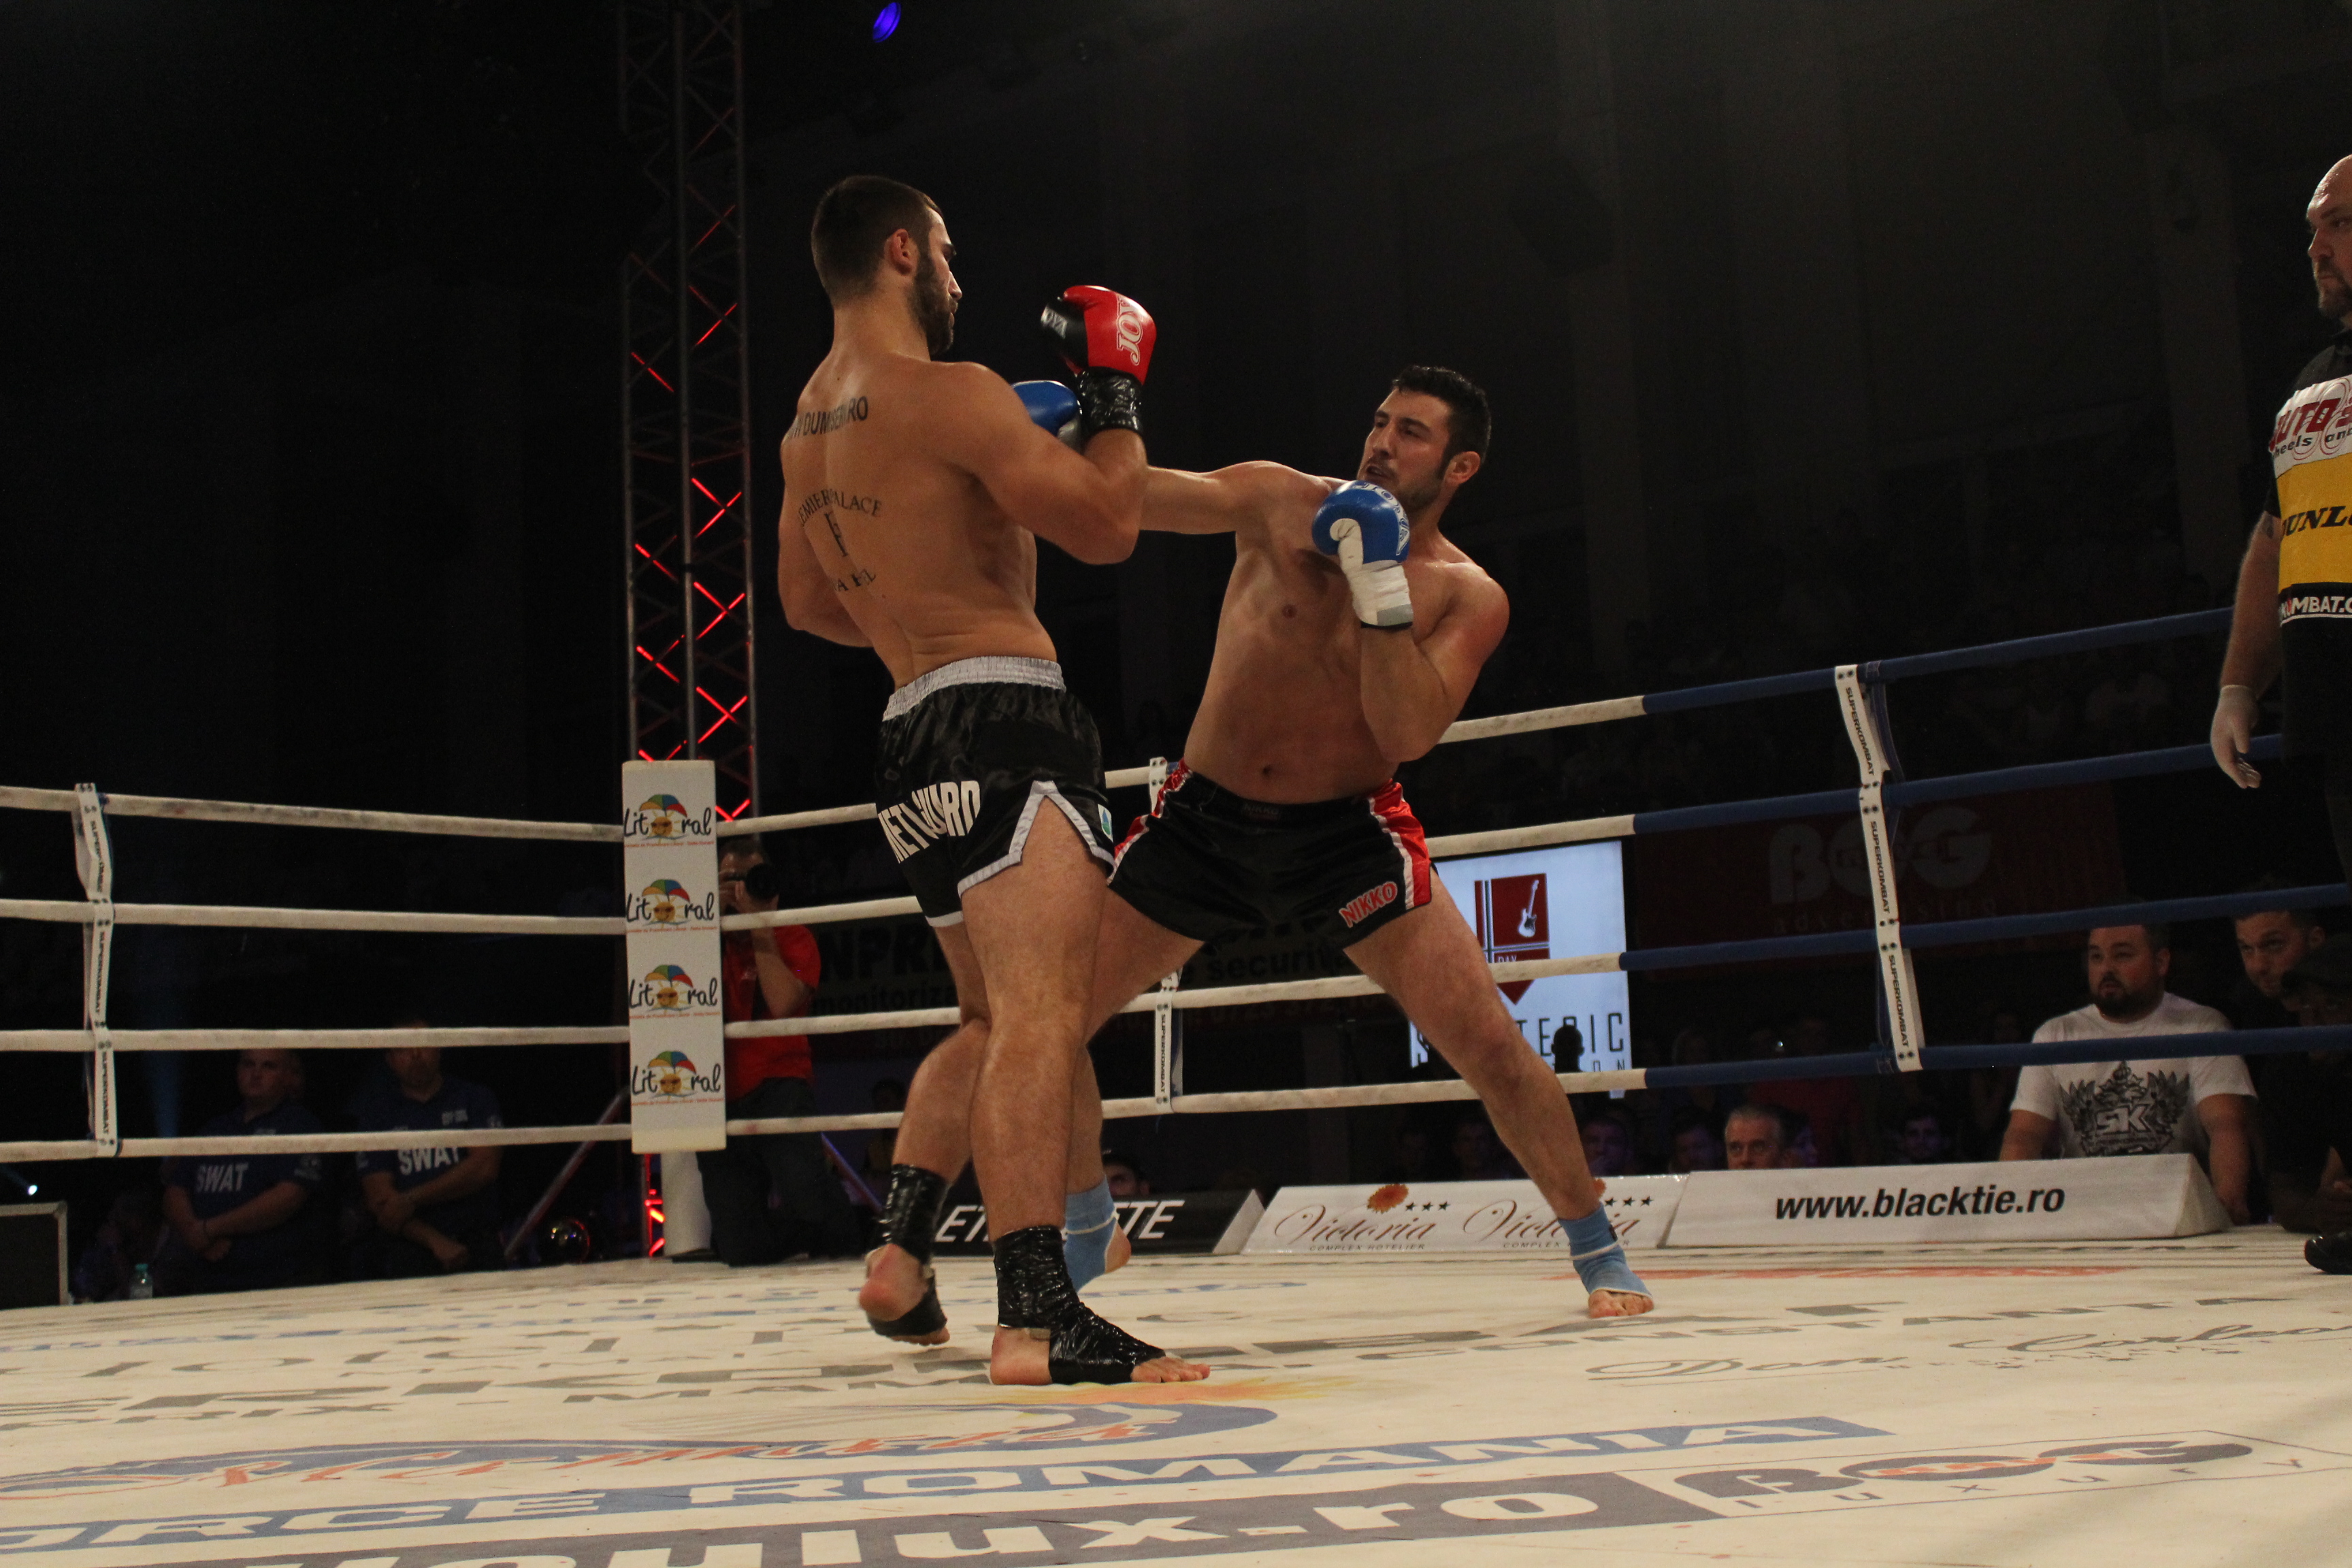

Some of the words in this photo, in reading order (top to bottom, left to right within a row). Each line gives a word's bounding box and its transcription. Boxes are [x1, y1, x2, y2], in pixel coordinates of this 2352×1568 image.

[2282, 506, 2352, 536] UNL
[1846, 687, 1875, 776] SUPERKOMBAT
[1870, 821, 1891, 913] SUPERKOMBAT
[1339, 881, 1398, 928] NIKKO
[1889, 954, 1909, 1048] SUPERKOMBAT
[196, 1162, 248, 1194] SWAT
[397, 1147, 462, 1176] SWAT
[1274, 1204, 1437, 1242] Victoria
[1775, 1185, 2065, 1220] www.blacktie.ro
[689, 1425, 1840, 1505] ROMANIA
[1740, 1458, 2302, 1508] luxury
